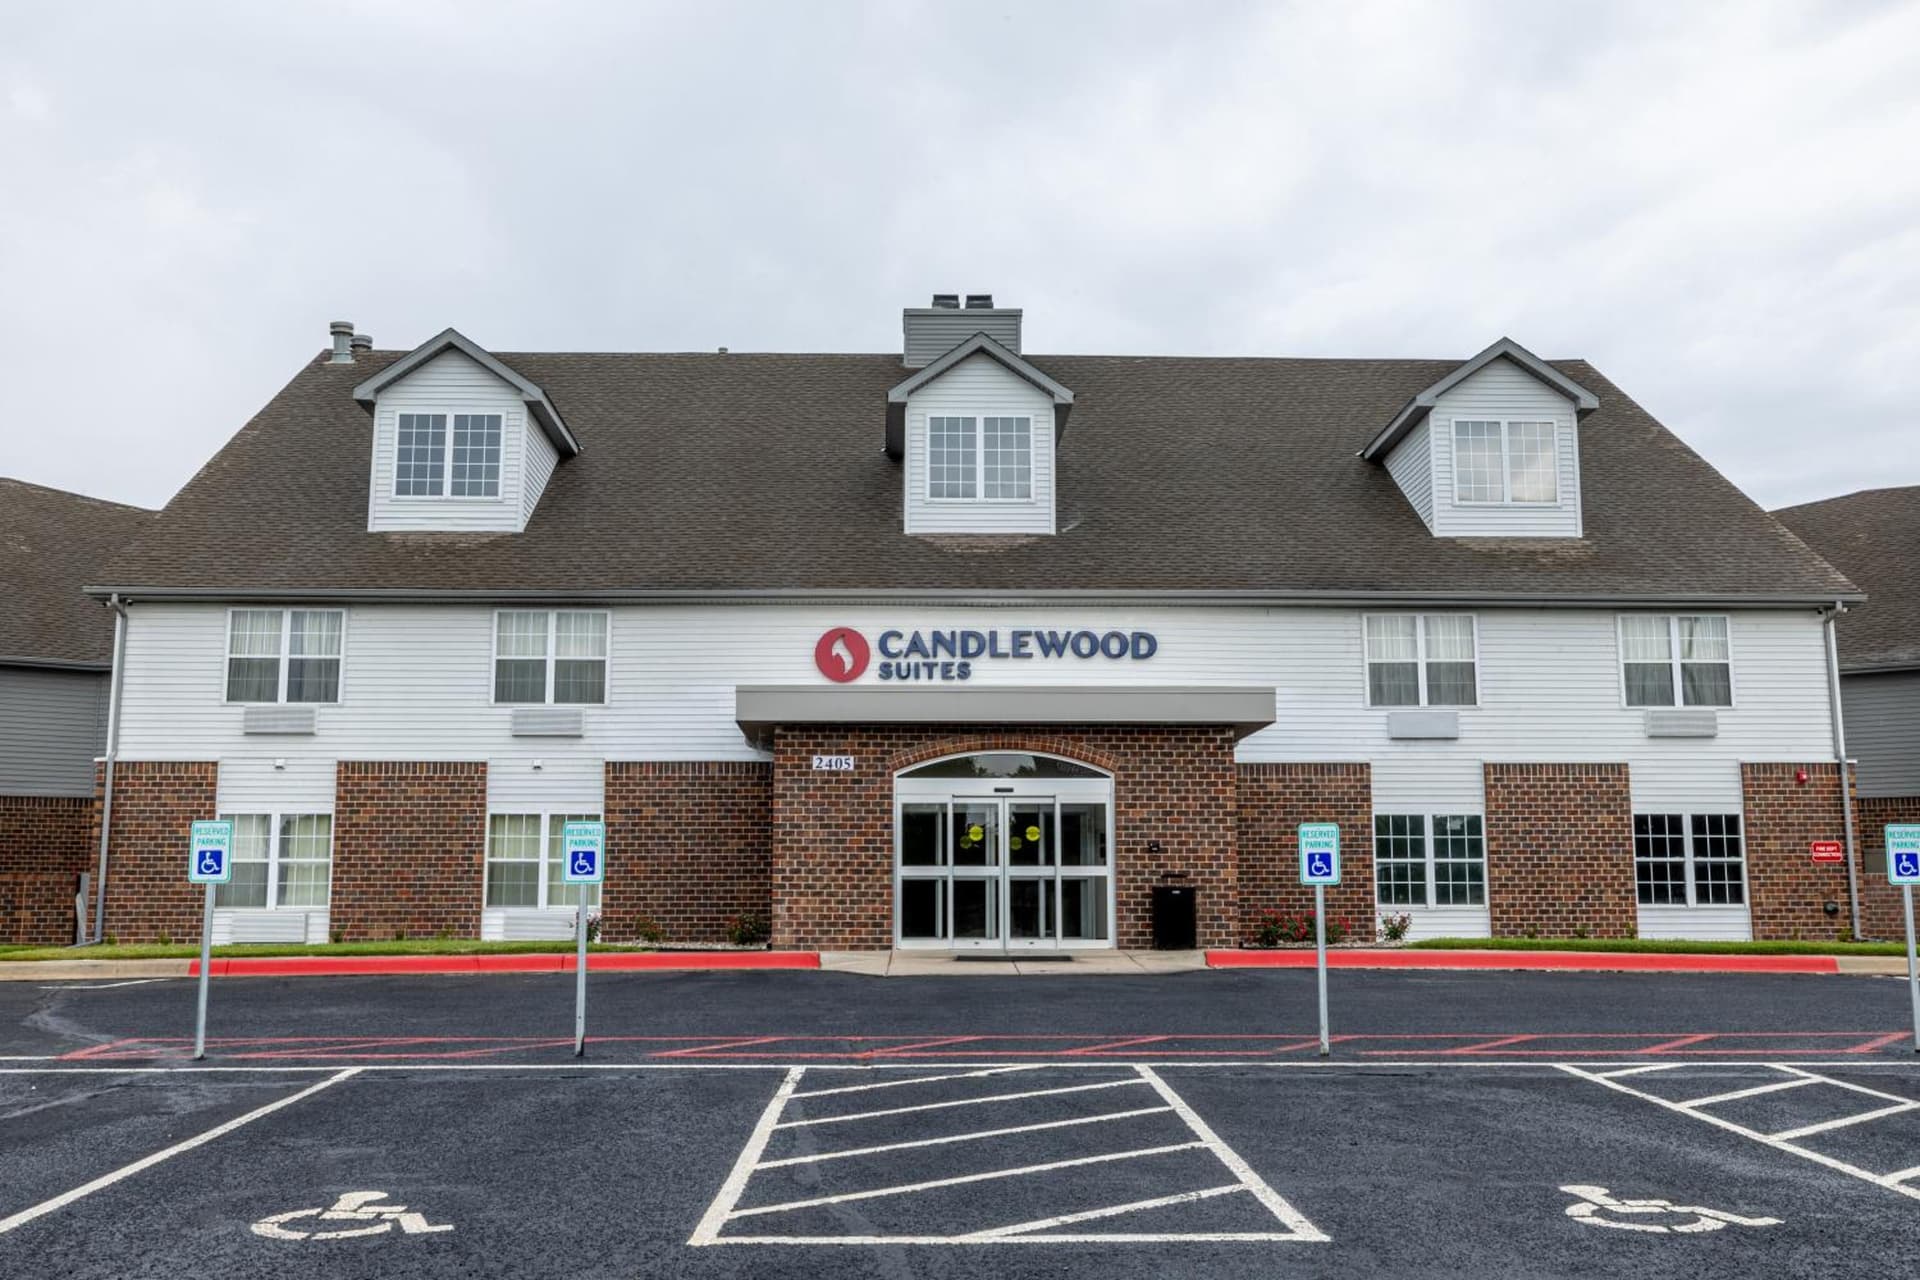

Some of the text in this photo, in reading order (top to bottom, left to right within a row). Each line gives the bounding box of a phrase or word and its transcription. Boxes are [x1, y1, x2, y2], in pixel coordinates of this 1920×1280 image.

[878, 630, 1158, 660] CANDLEWOOD
[878, 661, 972, 681] SUITES
[815, 757, 851, 770] 2405
[195, 827, 230, 835] RESERVED
[566, 828, 601, 836] RESERVED
[1301, 830, 1336, 838] RESERVED
[197, 838, 226, 846] PARKING
[569, 839, 598, 847] PARKING
